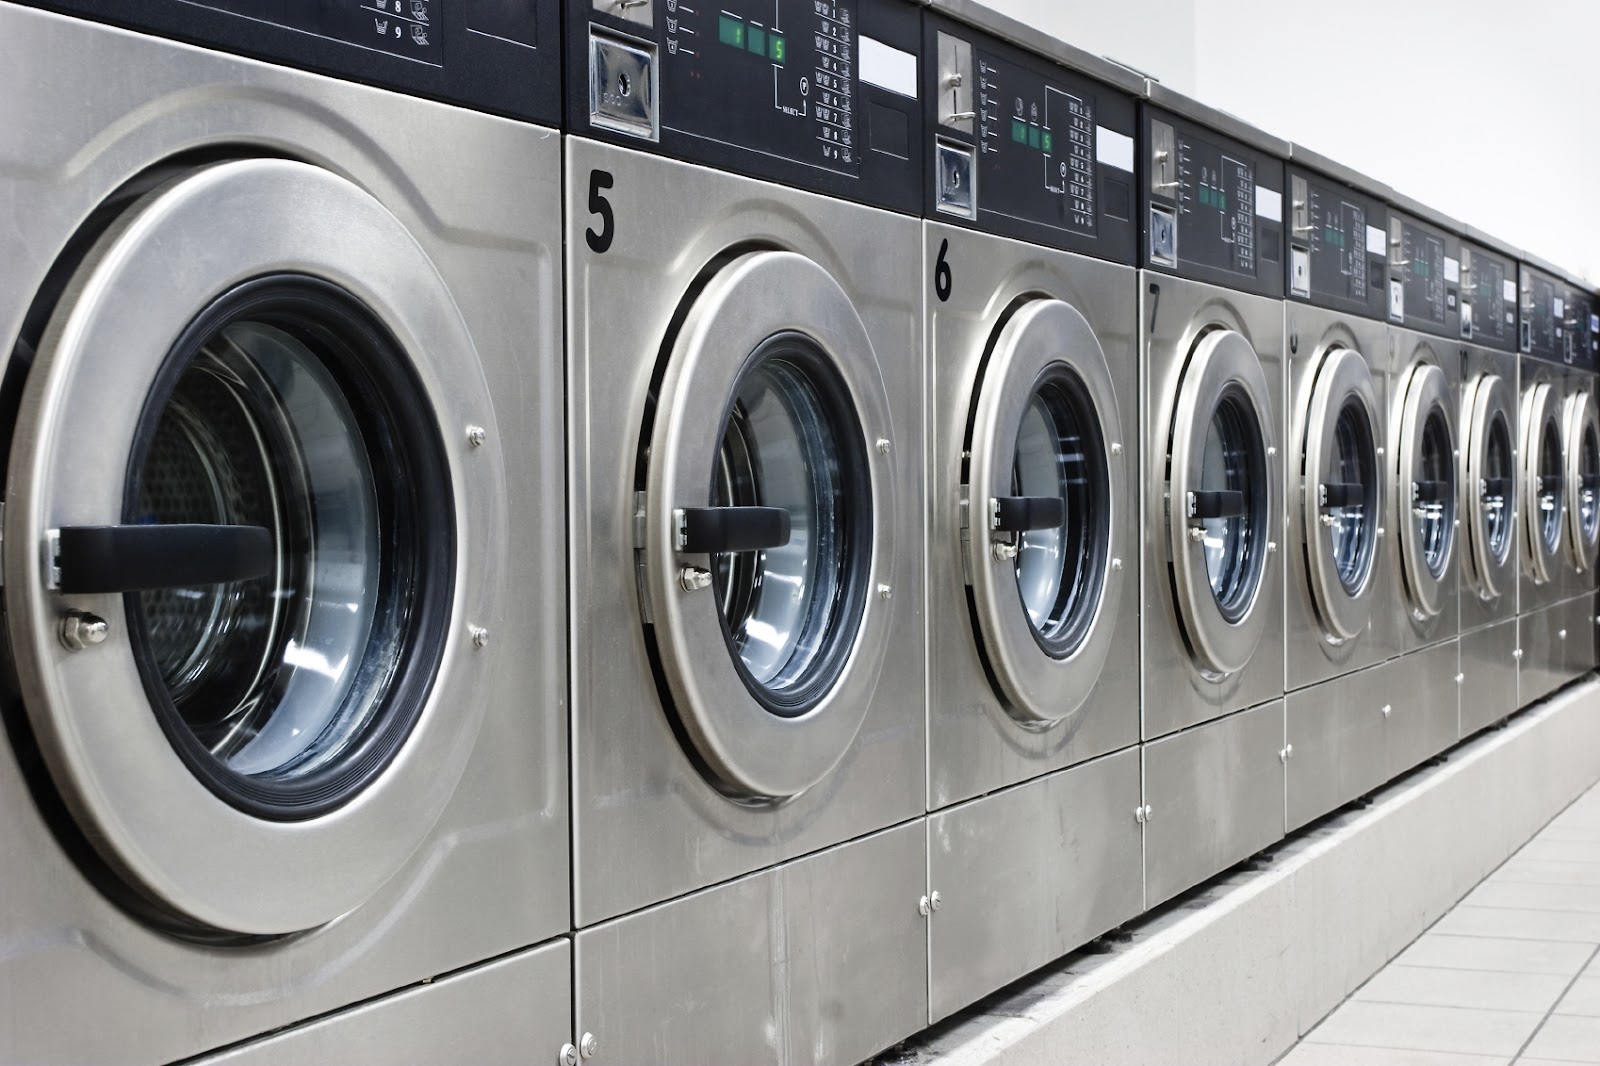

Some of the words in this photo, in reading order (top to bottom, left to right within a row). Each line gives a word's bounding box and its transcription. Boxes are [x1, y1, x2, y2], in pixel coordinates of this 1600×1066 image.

[394, 0, 402, 13] 8
[394, 26, 402, 39] 9
[585, 169, 615, 254] 5
[934, 237, 953, 302] 6
[1149, 283, 1160, 334] 7
